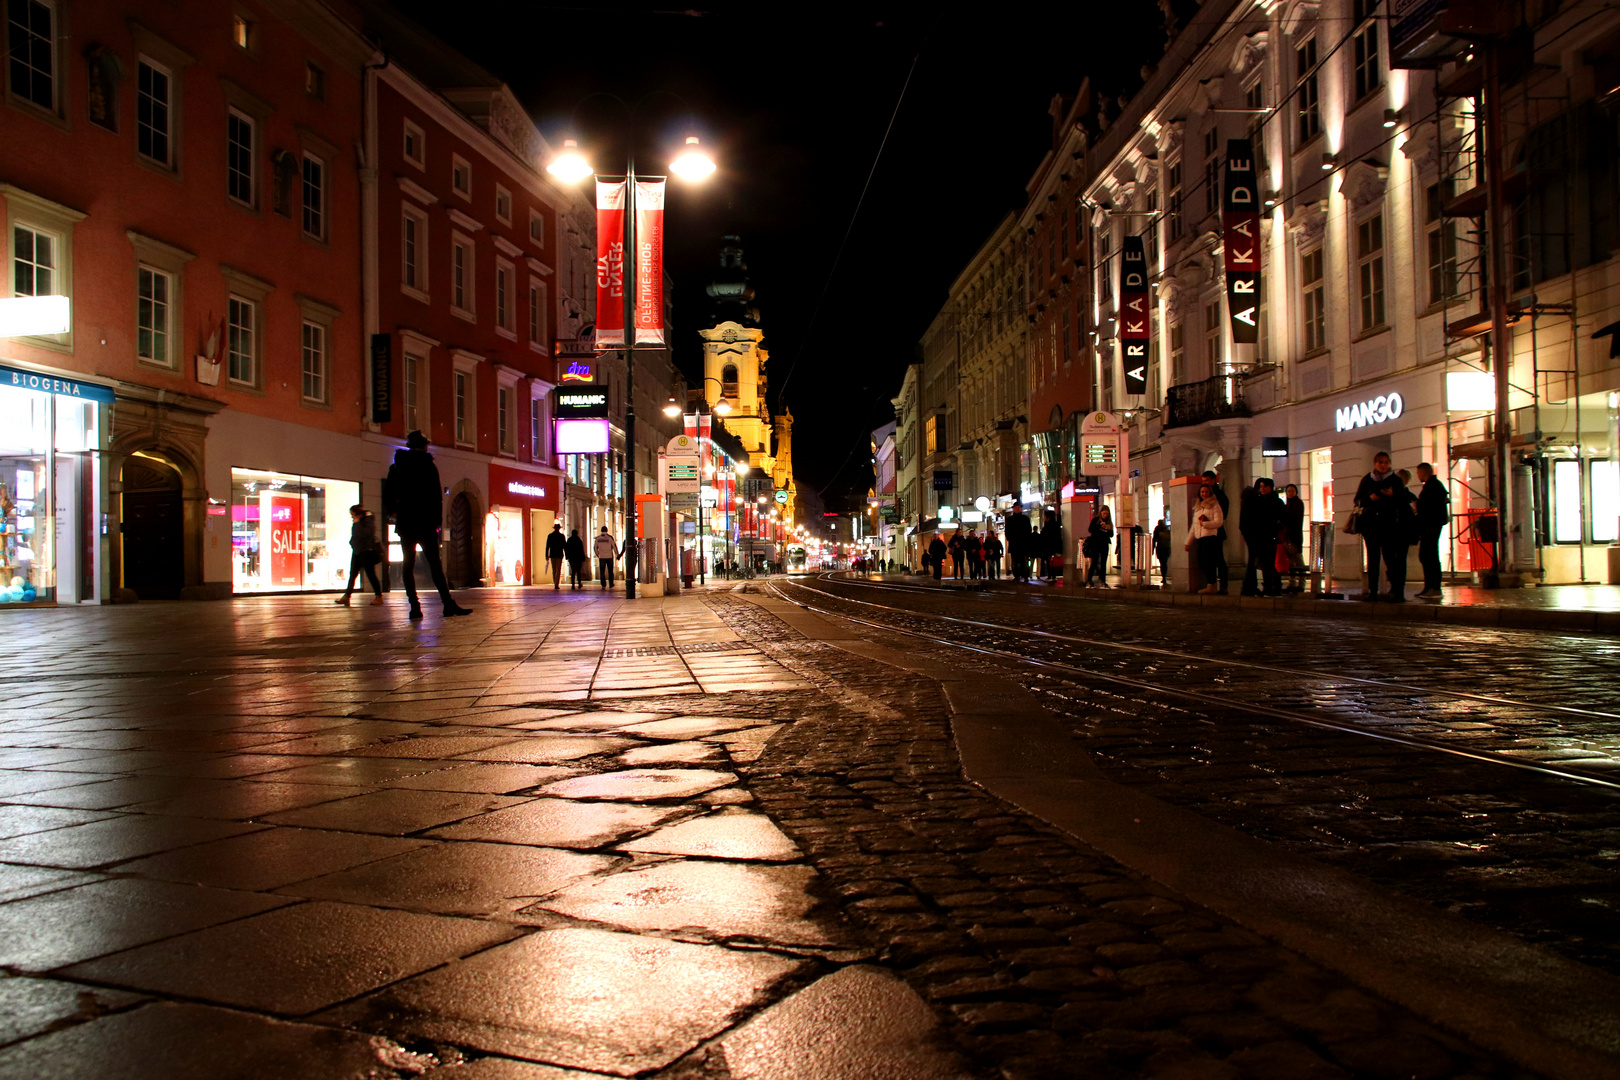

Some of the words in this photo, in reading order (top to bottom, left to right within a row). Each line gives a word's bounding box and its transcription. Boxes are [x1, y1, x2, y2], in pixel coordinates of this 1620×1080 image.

[1229, 158, 1256, 327] ARKADE
[1125, 250, 1145, 382] ARKADE
[12, 371, 81, 396] BIOGENA
[376, 345, 389, 412] HUMANIC
[567, 361, 590, 375] dm
[559, 394, 605, 405] HUMANIC
[1335, 392, 1403, 433] MANGO
[272, 529, 304, 554] SALE
